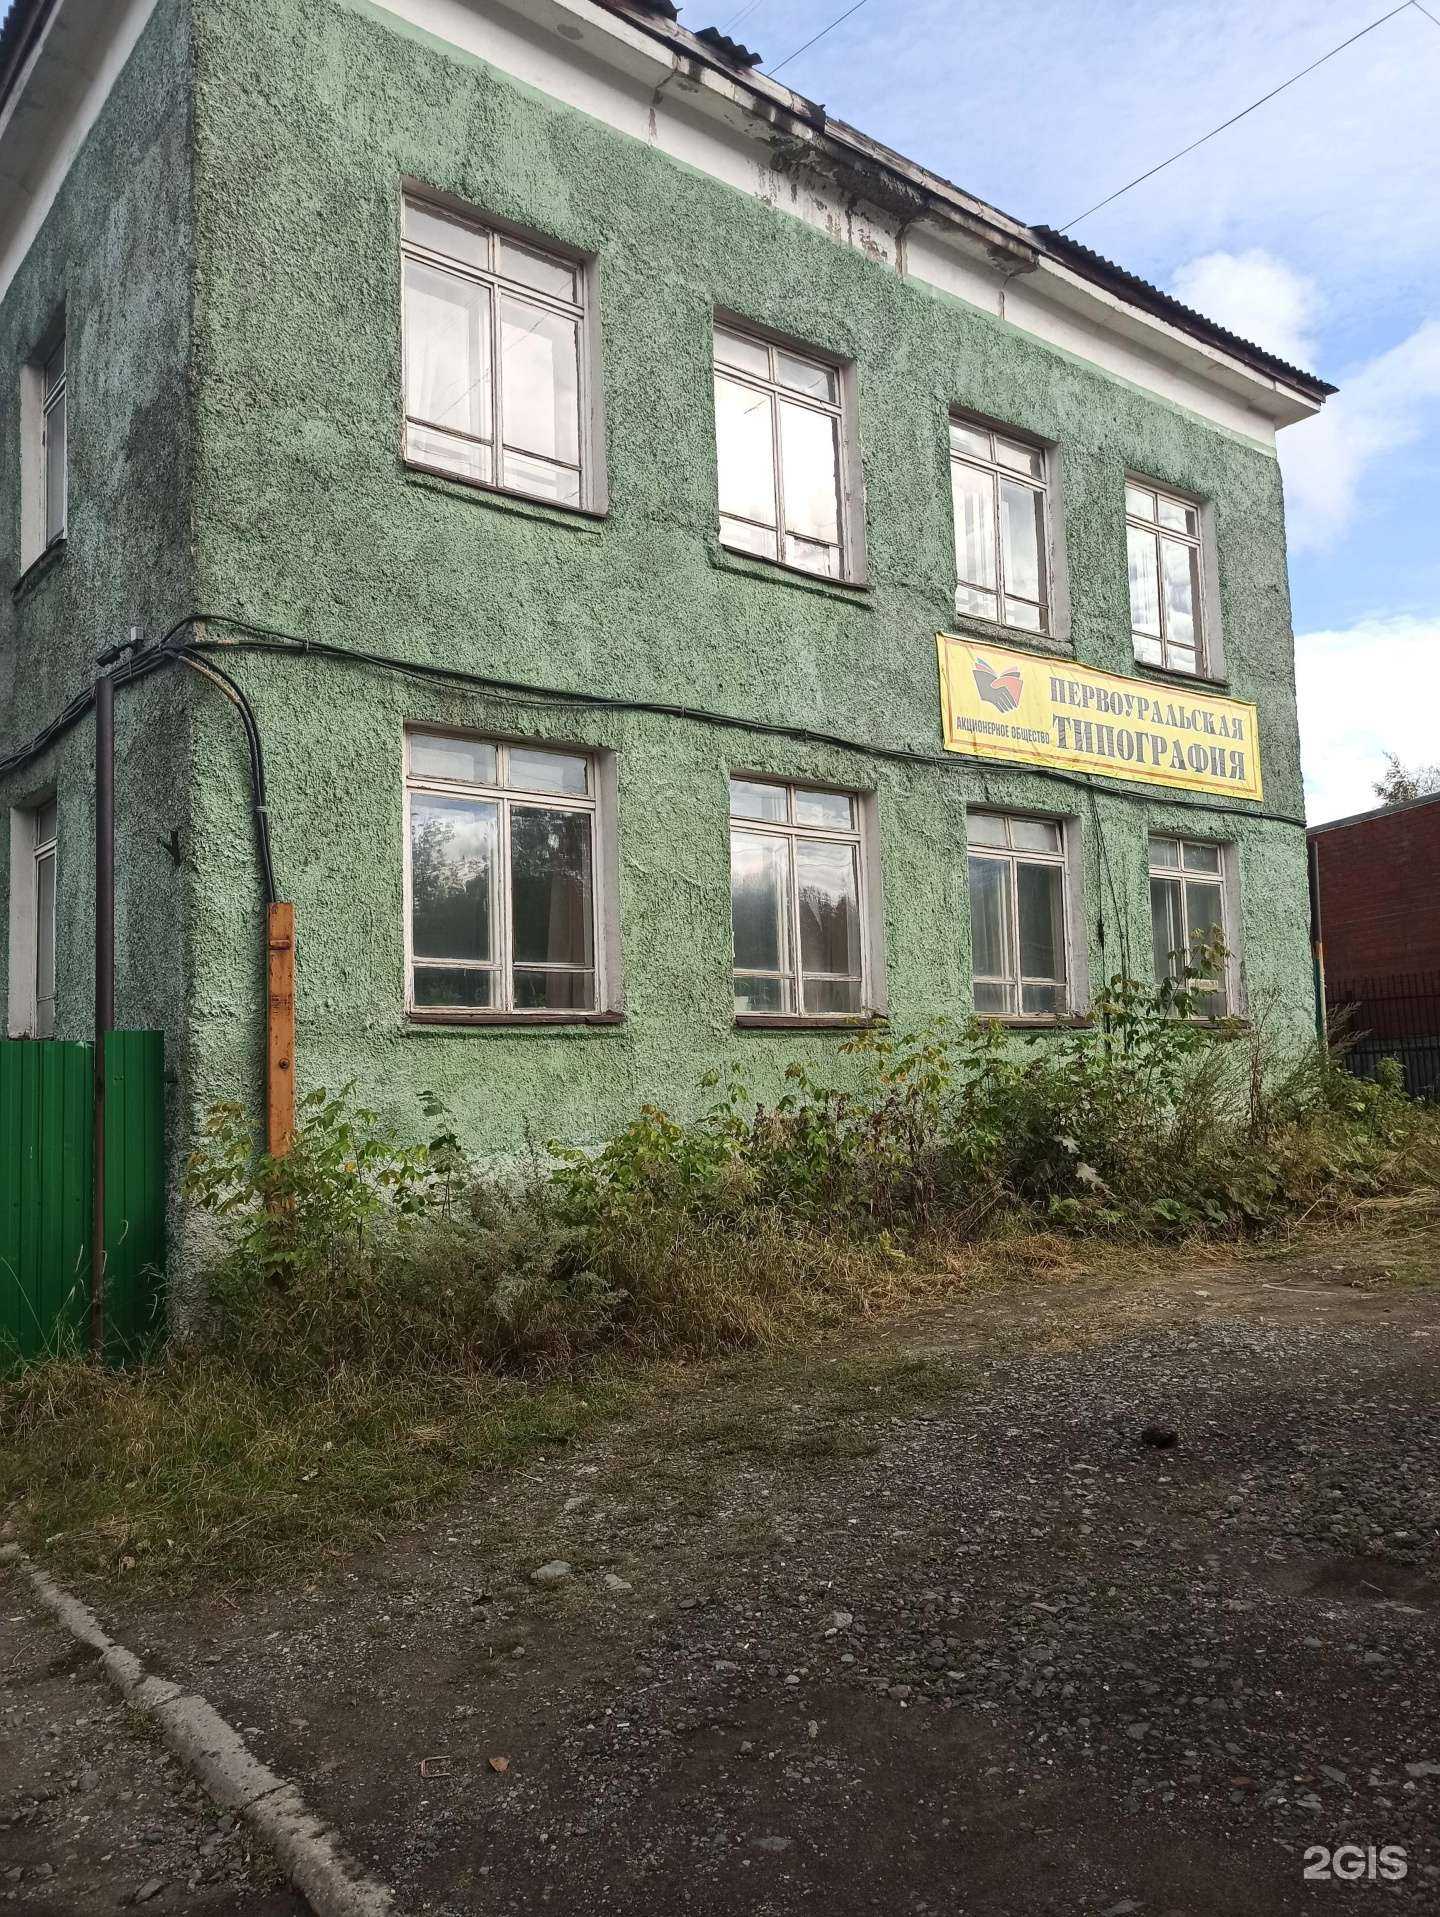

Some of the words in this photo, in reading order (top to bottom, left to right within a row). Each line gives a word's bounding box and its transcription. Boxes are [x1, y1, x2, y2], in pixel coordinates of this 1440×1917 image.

[956, 715, 1010, 739] АКЦИОНЕРНОЕ
[1011, 725, 1050, 745] ОБЩЕСТВО
[1048, 676, 1244, 741] ПЕРВОУРАЛЬСКАЯ
[1052, 713, 1247, 781] ТИПОГРАФИЯ
